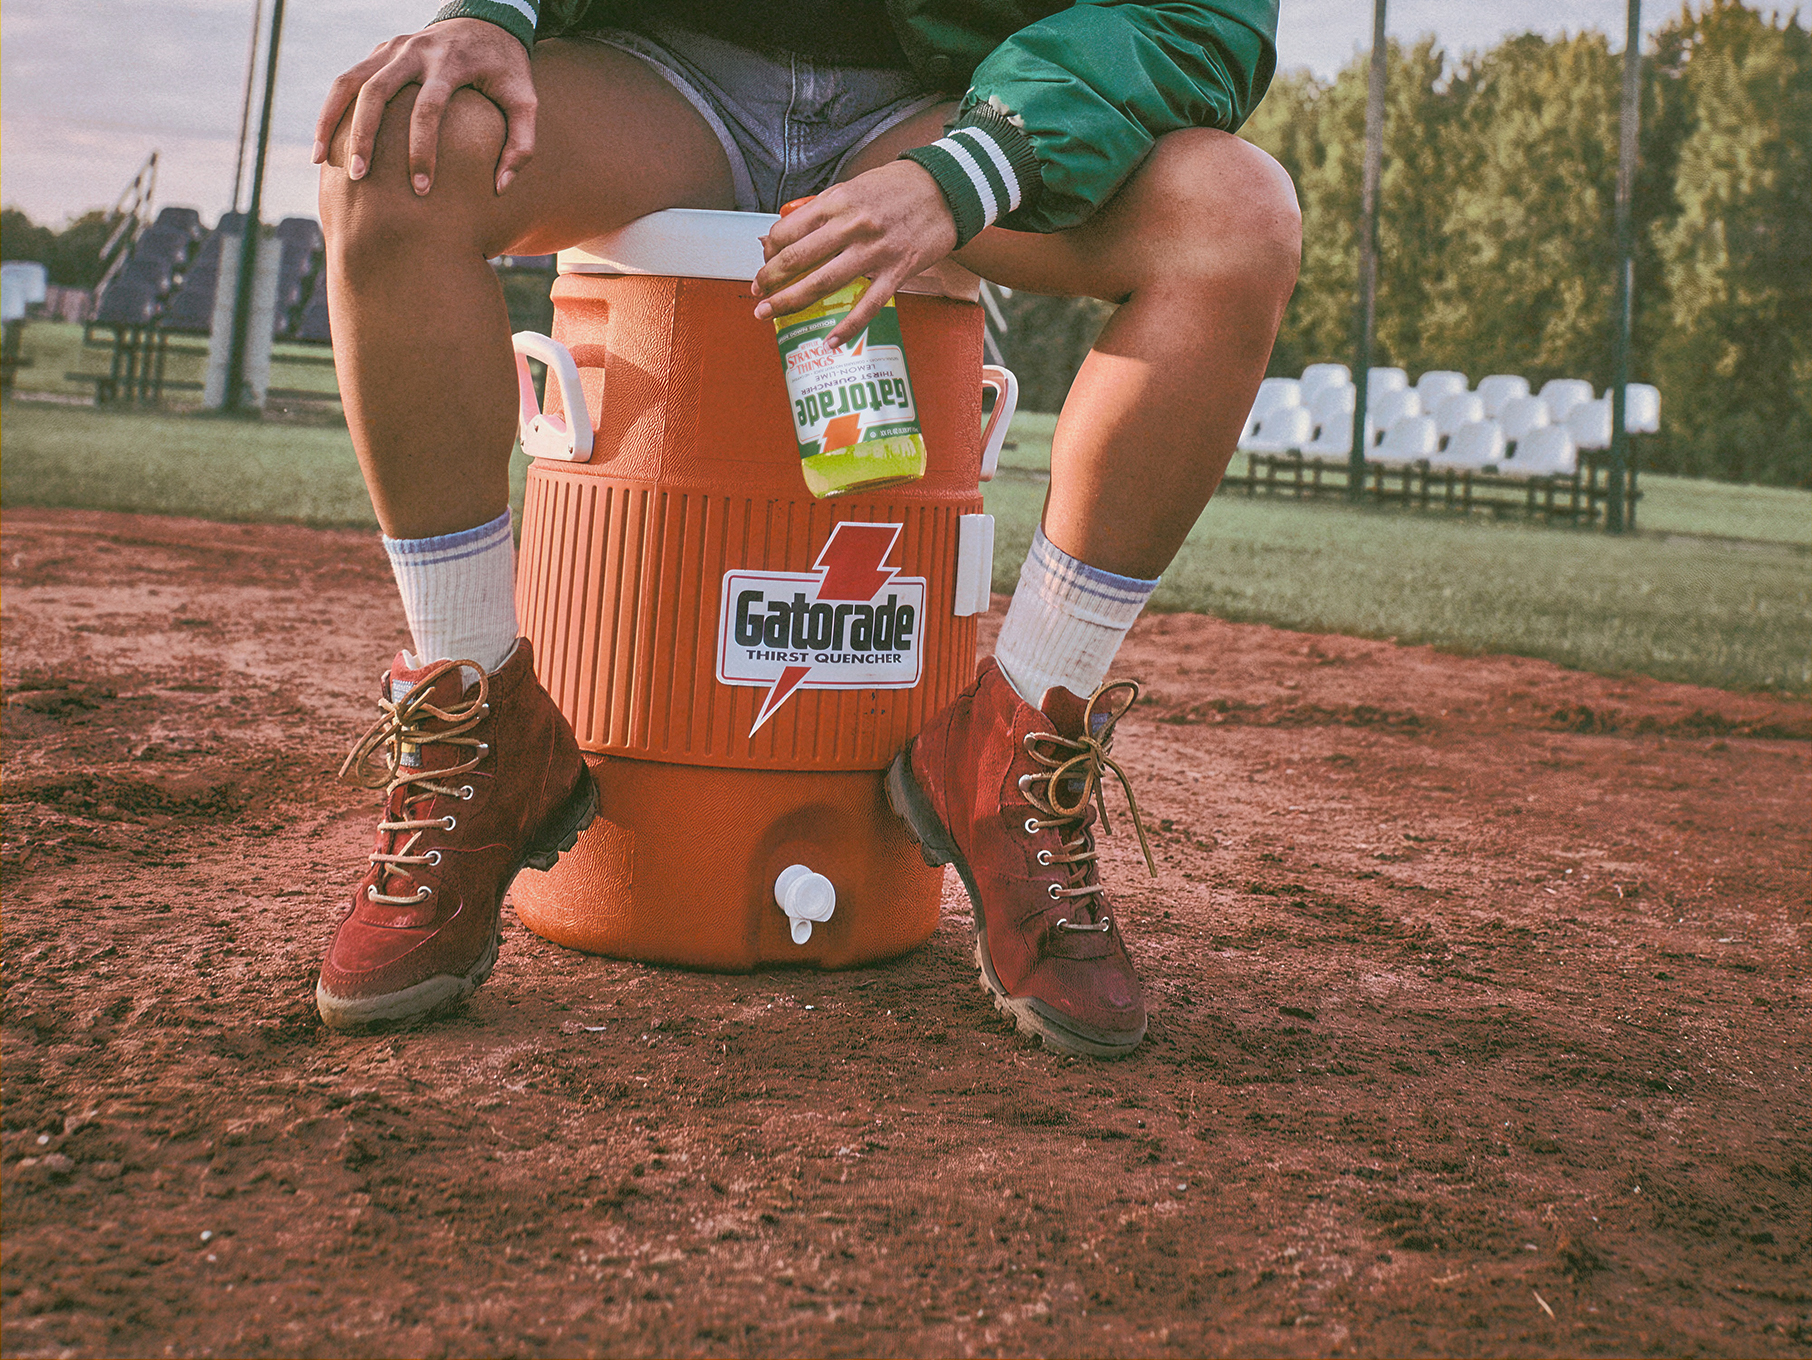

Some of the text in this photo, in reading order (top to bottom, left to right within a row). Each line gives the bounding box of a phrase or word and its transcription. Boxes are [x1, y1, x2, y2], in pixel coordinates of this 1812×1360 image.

[800, 340, 819, 350] NETFLIX
[797, 355, 835, 375] THINGS
[815, 363, 876, 382] LEMON-LIME
[801, 370, 894, 396] THIRST QUENCHER
[795, 377, 909, 427] Gatorade
[734, 590, 915, 651] Gatorade
[746, 649, 902, 664] THIRST QUENCHER
